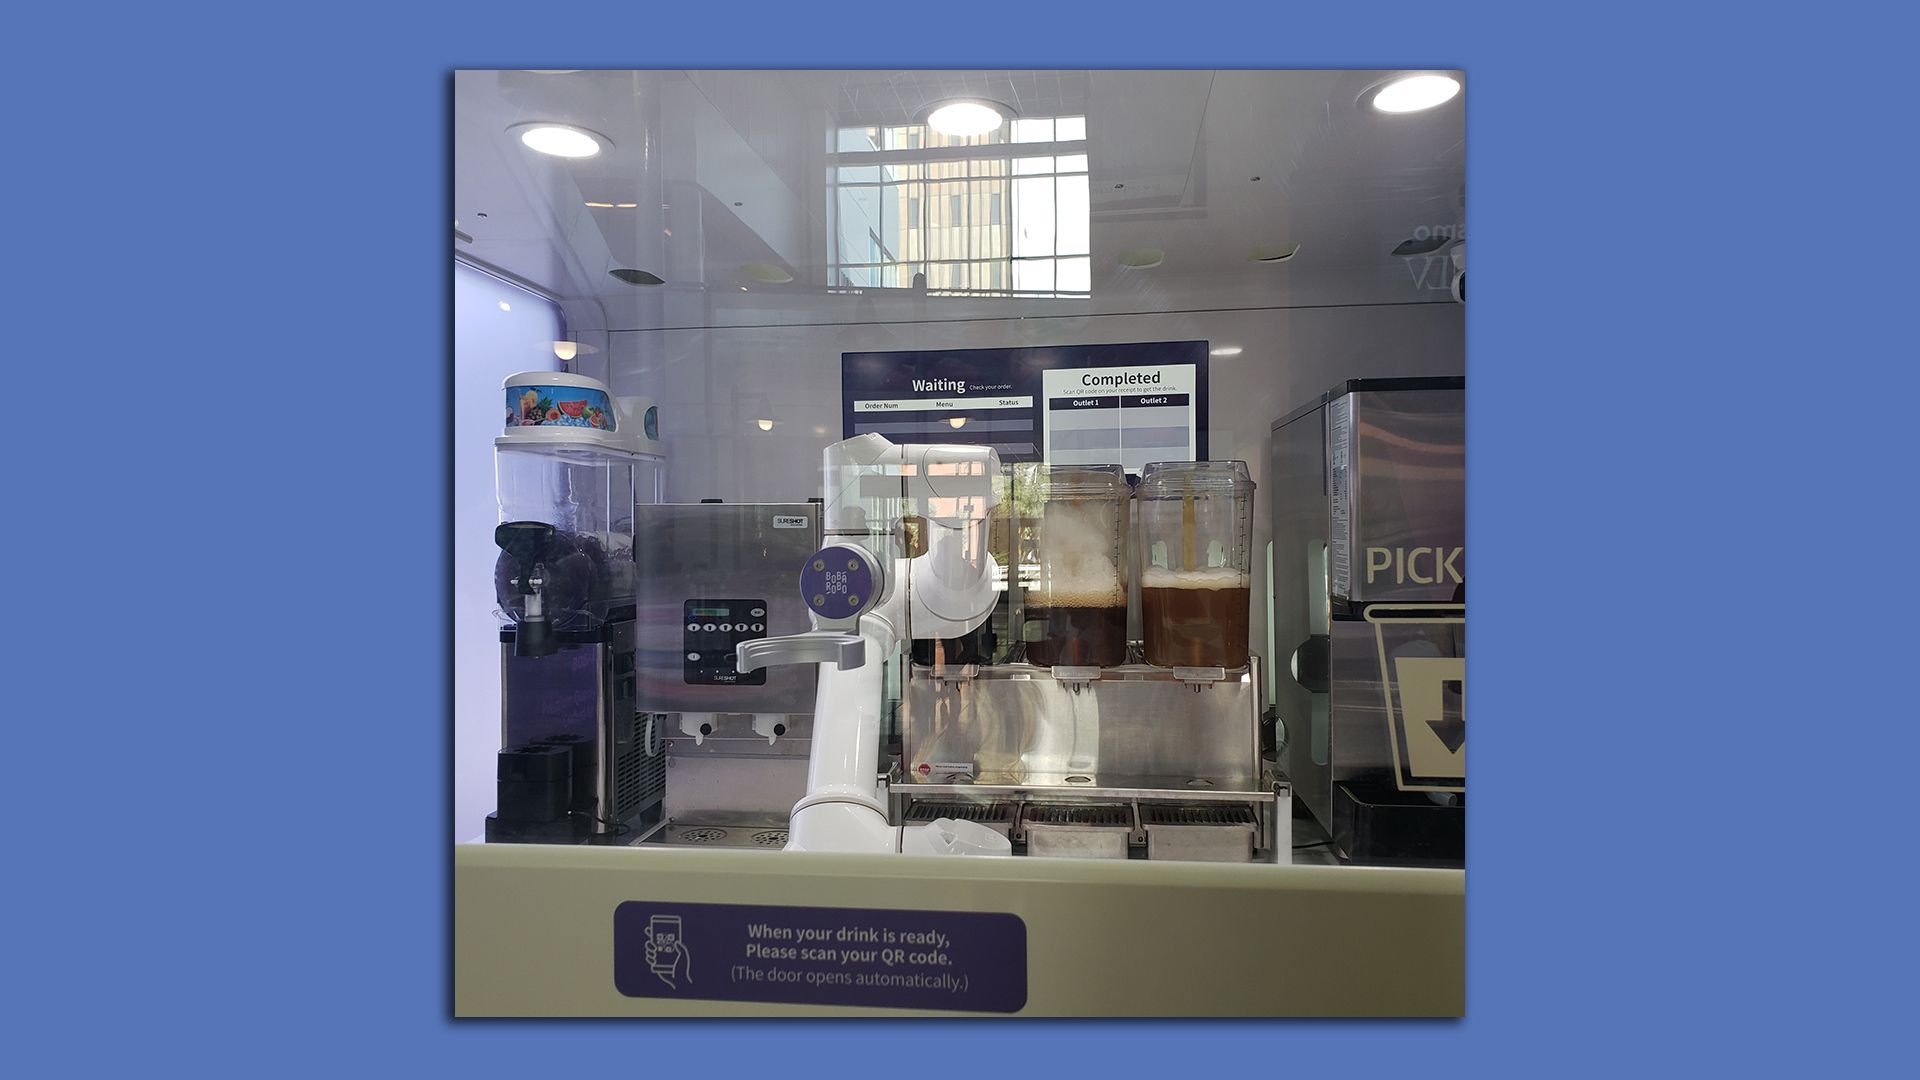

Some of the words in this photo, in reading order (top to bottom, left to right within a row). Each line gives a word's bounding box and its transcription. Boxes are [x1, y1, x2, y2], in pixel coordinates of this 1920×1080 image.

[912, 378, 966, 394] Waiting
[1082, 371, 1161, 387] Completed
[1072, 399, 1094, 407] Outlet
[1366, 547, 1464, 584] PICK
[748, 924, 792, 939] When
[796, 928, 833, 943] your
[836, 926, 879, 942] drink
[883, 928, 896, 943] is
[900, 929, 950, 948] ready,
[746, 943, 797, 959] Please
[801, 948, 837, 961] scan
[841, 950, 877, 965] your
[881, 948, 905, 966] QR
[909, 950, 952, 965] code.
[731, 965, 764, 983] (The
[767, 966, 803, 982] door
[806, 971, 852, 986] opens
[856, 972, 969, 992] automatically.)
